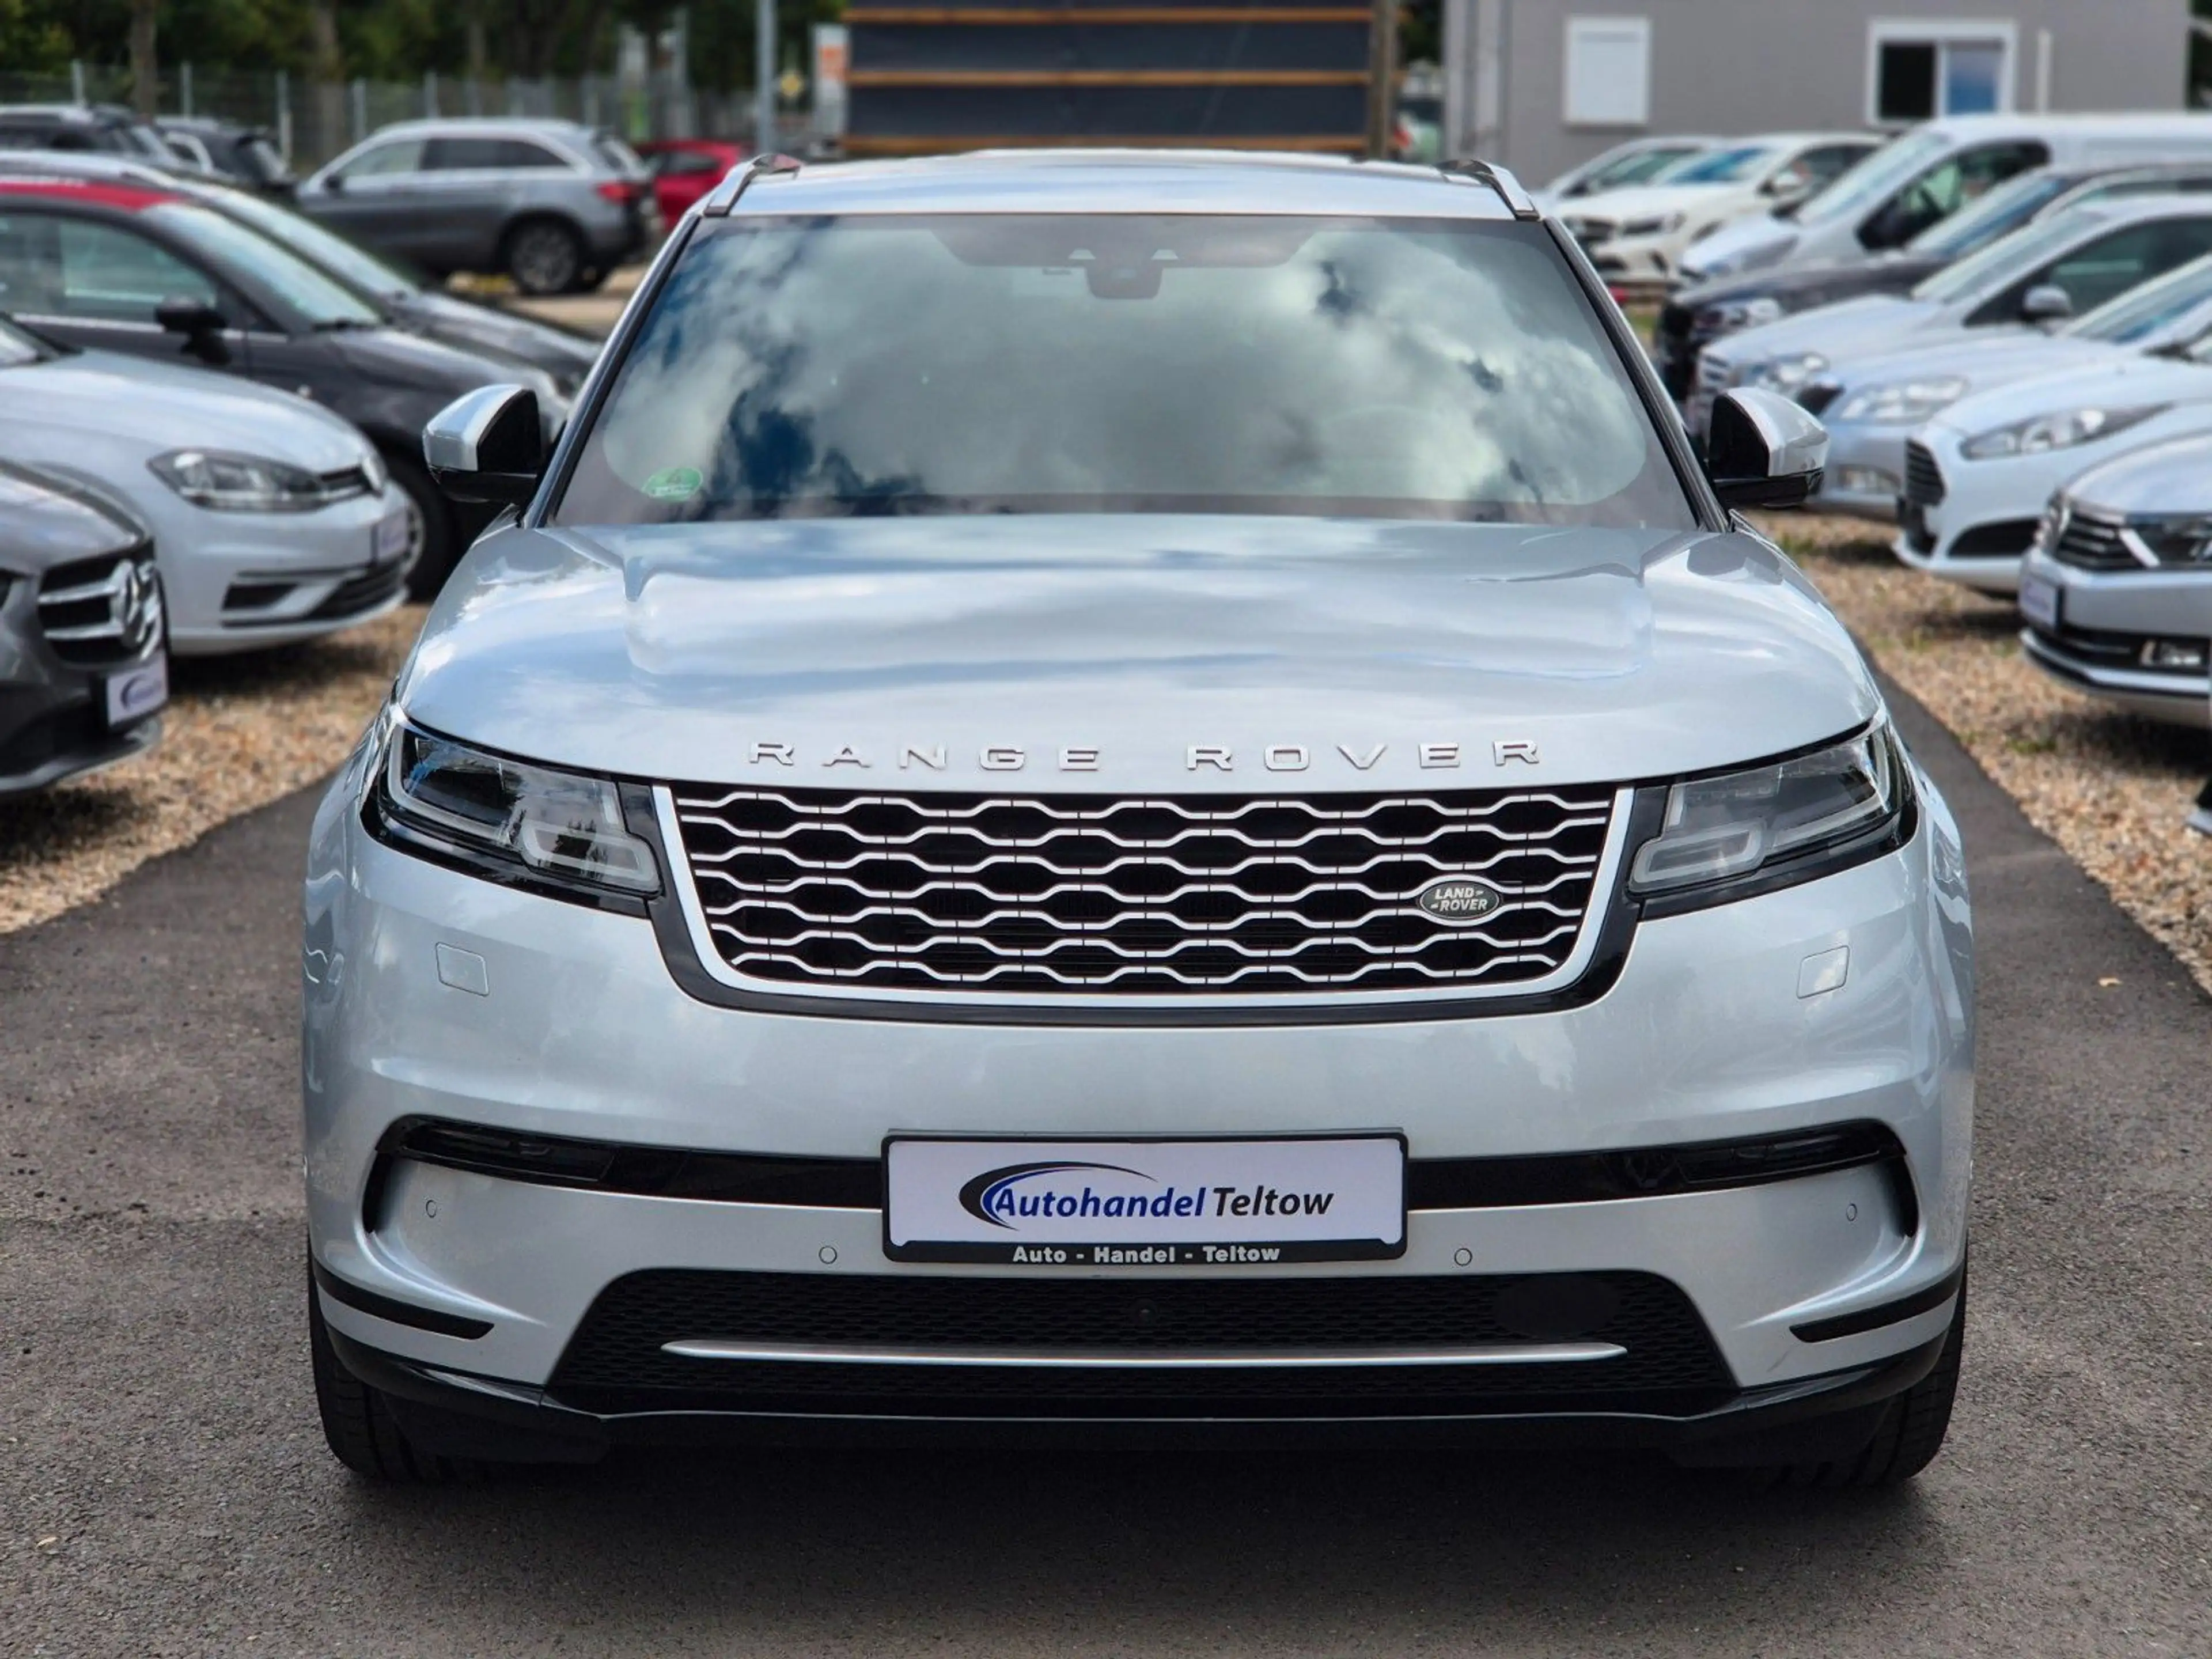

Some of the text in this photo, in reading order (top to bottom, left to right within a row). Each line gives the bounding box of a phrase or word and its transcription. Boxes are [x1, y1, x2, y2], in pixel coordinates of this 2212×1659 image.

[748, 740, 1540, 771] RANGE ROVER
[1013, 1246, 1066, 1263] Auto
[1094, 1246, 1175, 1263] Handel
[1203, 1245, 1280, 1262] Teltow
